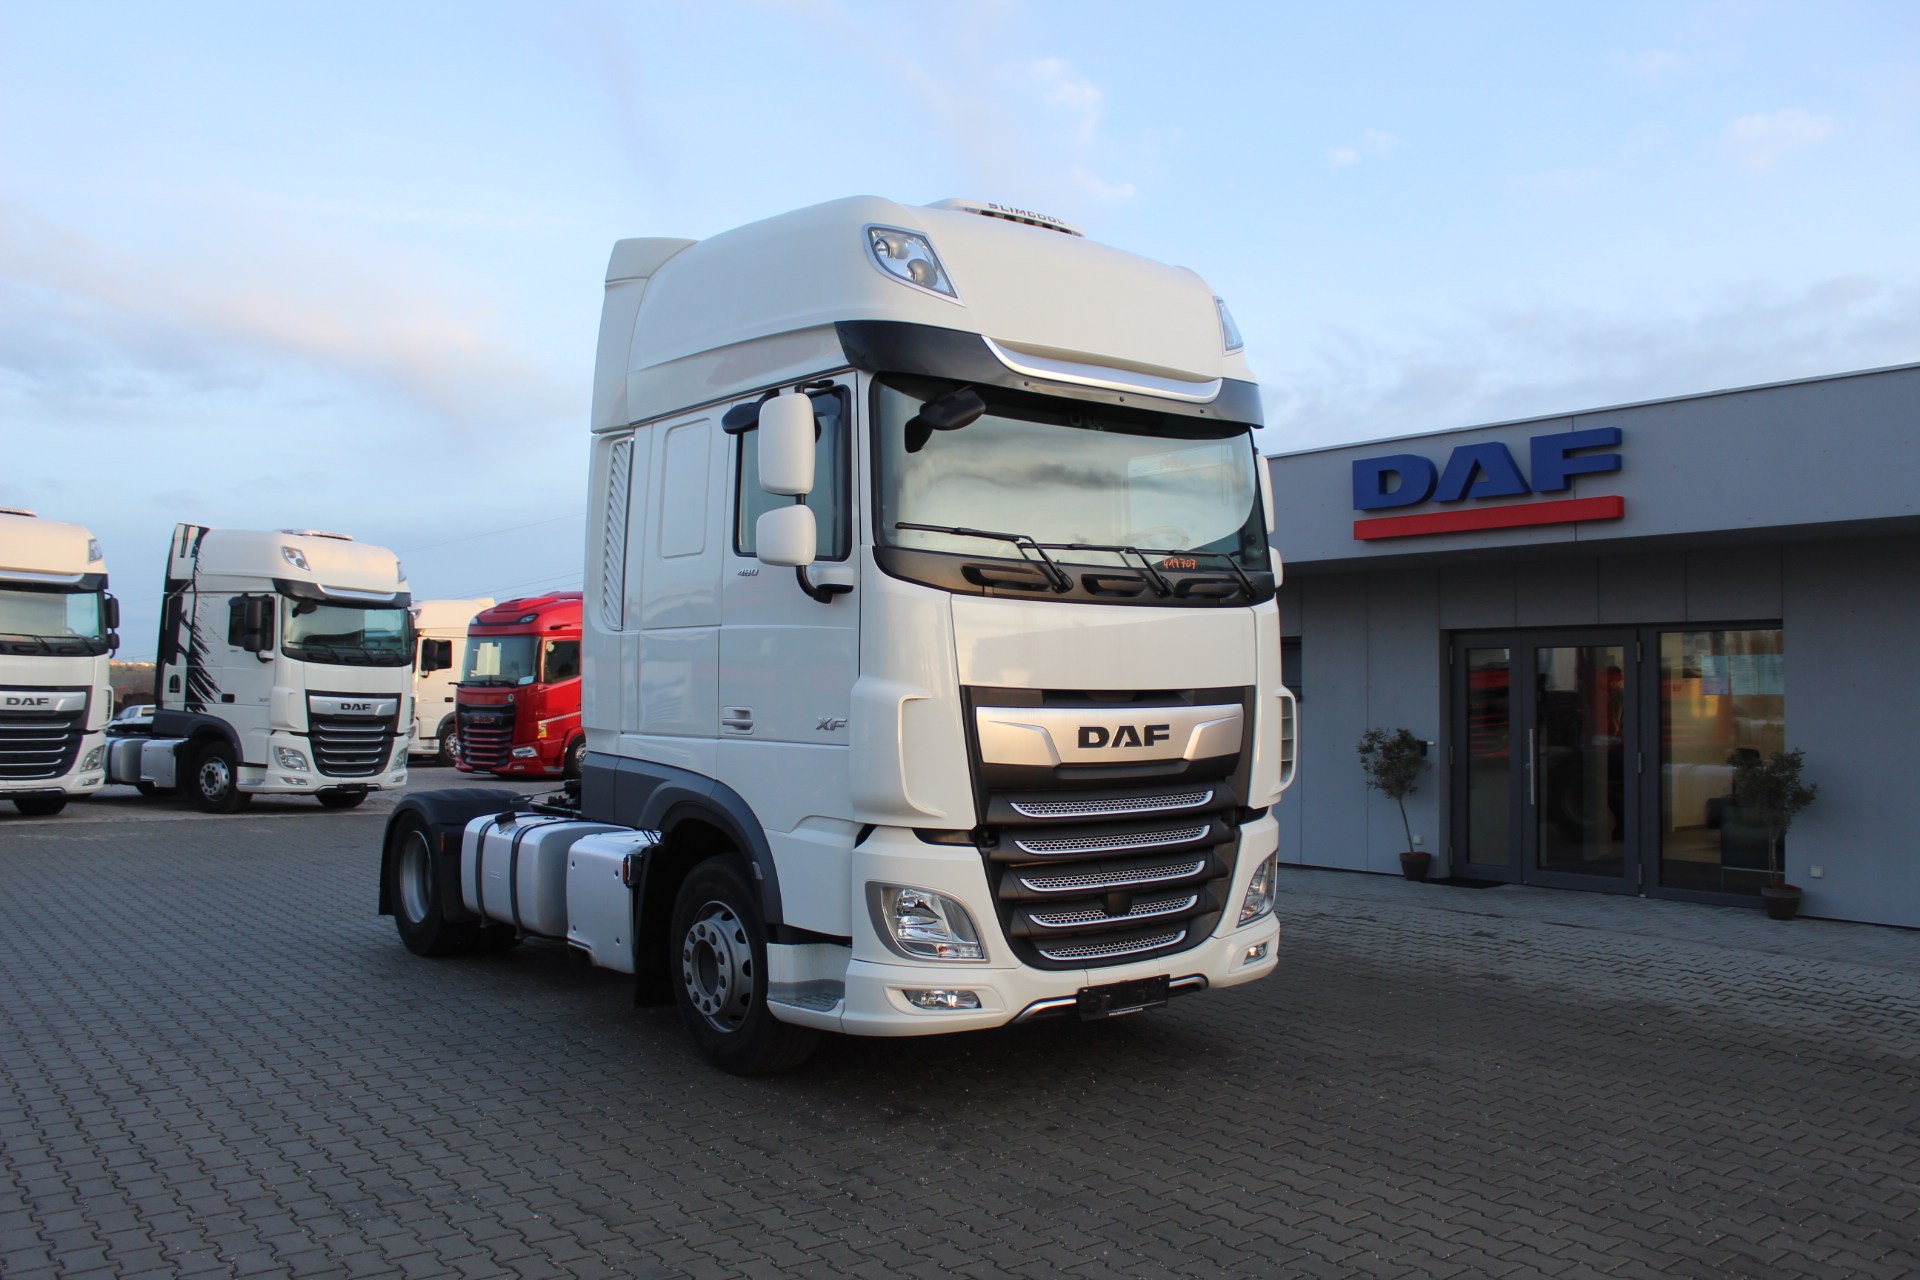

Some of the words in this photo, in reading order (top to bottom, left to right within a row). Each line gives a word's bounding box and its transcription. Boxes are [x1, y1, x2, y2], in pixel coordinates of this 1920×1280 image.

[1352, 427, 1622, 511] DAF
[6, 697, 49, 706] DAF
[340, 702, 372, 711] DAF
[815, 717, 848, 731] XF
[1078, 724, 1170, 749] DAF
